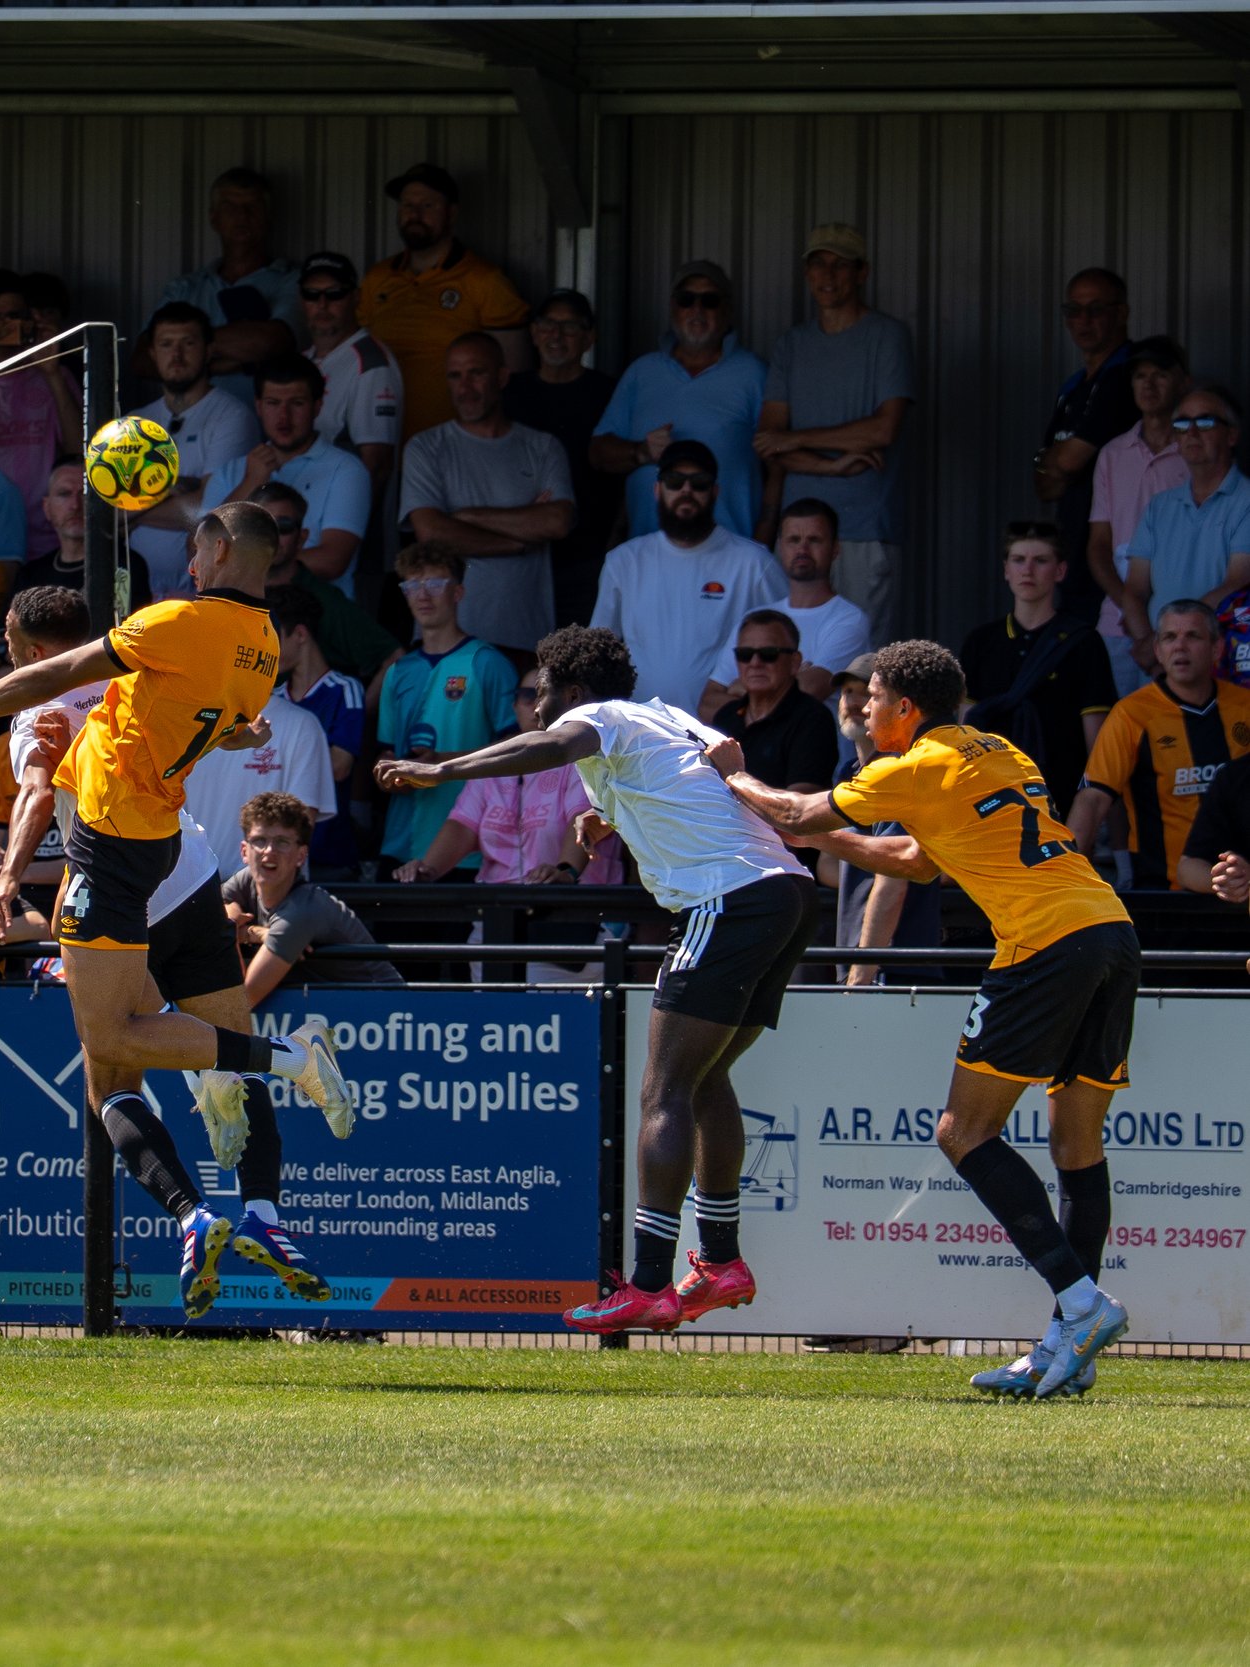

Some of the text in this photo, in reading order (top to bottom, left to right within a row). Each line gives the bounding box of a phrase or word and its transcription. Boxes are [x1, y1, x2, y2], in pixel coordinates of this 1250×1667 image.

[252, 650, 278, 679] Hill
[488, 804, 552, 821] BRKS
[61, 873, 90, 918] 4
[479, 1014, 561, 1053] and
[398, 1072, 580, 1122] Supplies
[819, 1106, 881, 1142] A.R.
[16, 1151, 85, 1177] Come
[280, 1163, 561, 1189] We deliver across East Anglia,
[278, 1189, 530, 1212] Greater London, Midlands
[822, 1175, 1241, 1200] Norman Way Indus Cambridgeshire
[278, 1216, 497, 1242] and surrounding areas
[823, 1221, 855, 1241] Tel:
[863, 1221, 928, 1242] 01954
[1106, 1226, 1158, 1247] 1954
[1163, 1227, 1247, 1249] 234967
[8, 1281, 74, 1296] PITCHED
[218, 1285, 269, 1300] ETING
[409, 1288, 562, 1305] & ALL ACCESSORIES
